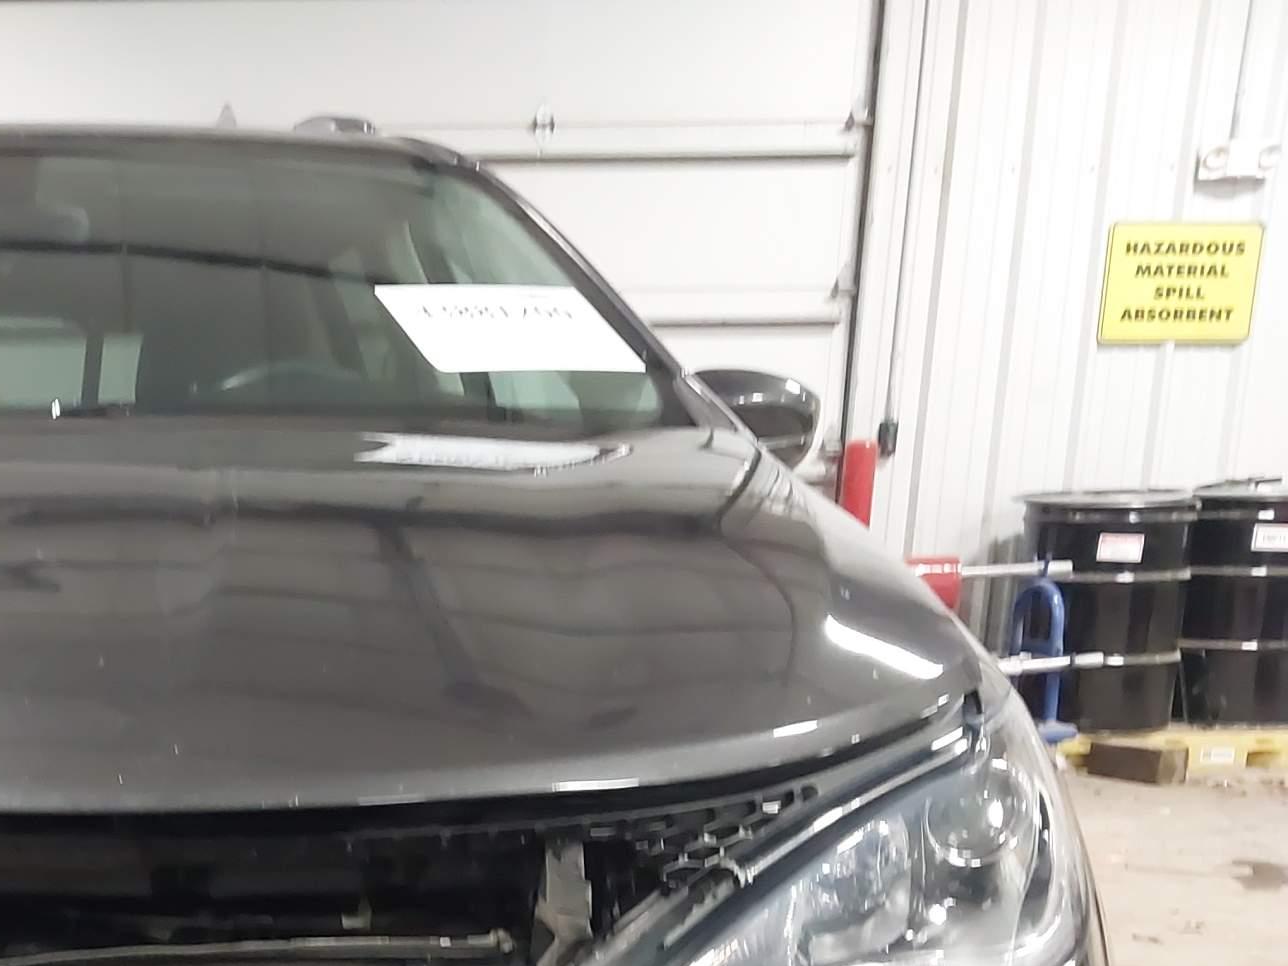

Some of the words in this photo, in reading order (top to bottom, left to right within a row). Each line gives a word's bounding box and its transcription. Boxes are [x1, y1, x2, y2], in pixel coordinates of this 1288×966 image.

[1125, 241, 1246, 255] HAZARDOUS
[1135, 264, 1229, 278] MATERIAL
[1154, 286, 1205, 300] SPILL
[1120, 308, 1234, 322] ABSORBENT
